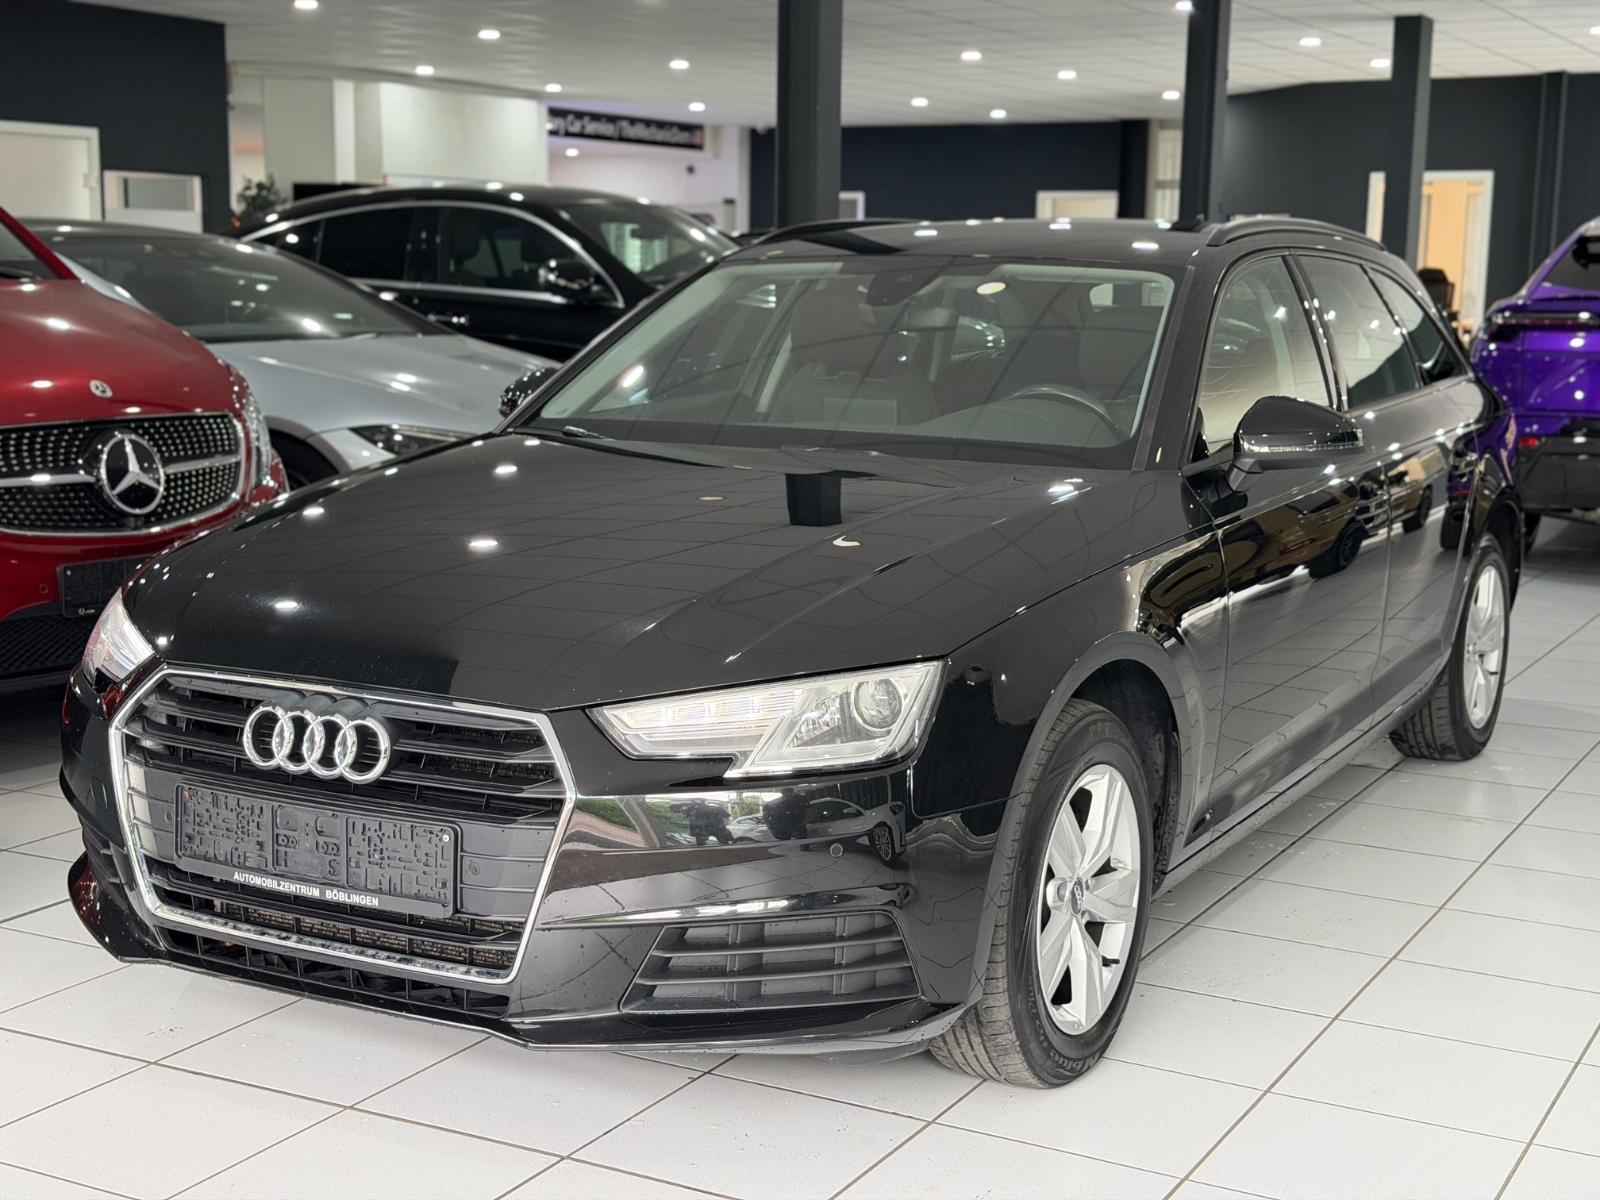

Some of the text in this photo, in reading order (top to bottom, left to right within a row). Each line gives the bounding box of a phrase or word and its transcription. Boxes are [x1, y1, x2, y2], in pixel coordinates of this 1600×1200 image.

[233, 871, 379, 906] AUTOMOBILZENTRUM BÖBLINGEN
[1049, 1049, 1084, 1071] blue
